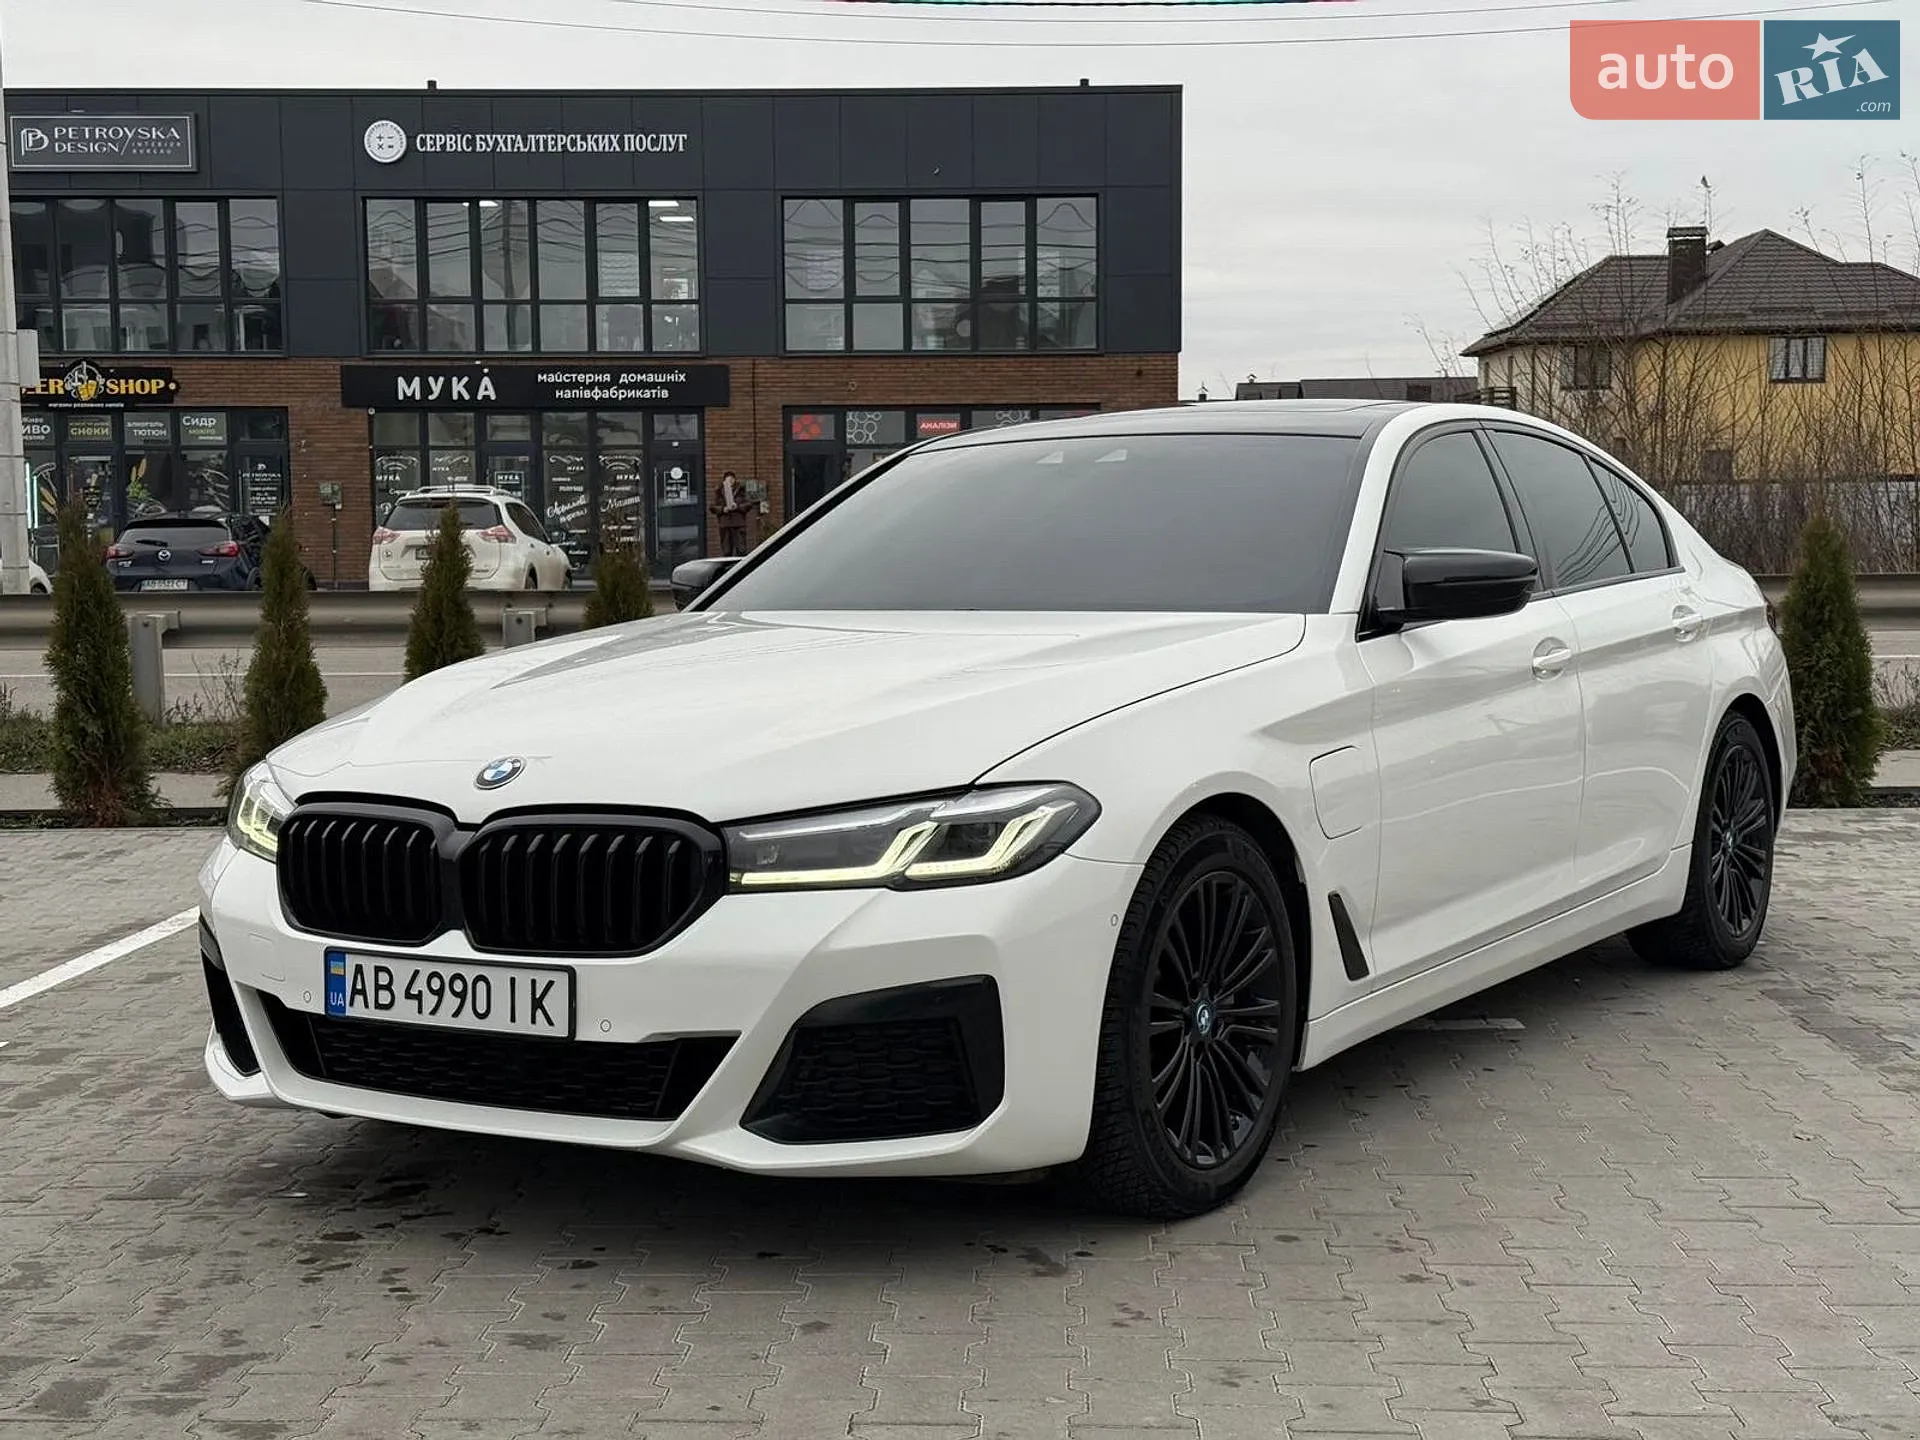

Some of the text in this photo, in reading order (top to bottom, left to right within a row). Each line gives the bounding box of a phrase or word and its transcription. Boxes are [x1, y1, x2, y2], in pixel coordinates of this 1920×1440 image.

[54, 126, 180, 143] PETROVSKA
[416, 133, 472, 152] СЕРВІС
[475, 133, 621, 152] БУХГАЛТЕРСЬКИХ
[623, 133, 688, 152] ПОСЛУГ
[54, 141, 119, 154] DESIGN
[537, 370, 687, 385] майстерня домашніх
[105, 378, 166, 395] SHOP
[555, 386, 670, 401] напівфабрикатів
[182, 415, 217, 429] Сидр
[329, 991, 345, 1007] UA
[349, 963, 396, 1011] AB
[404, 968, 492, 1020] 4990
